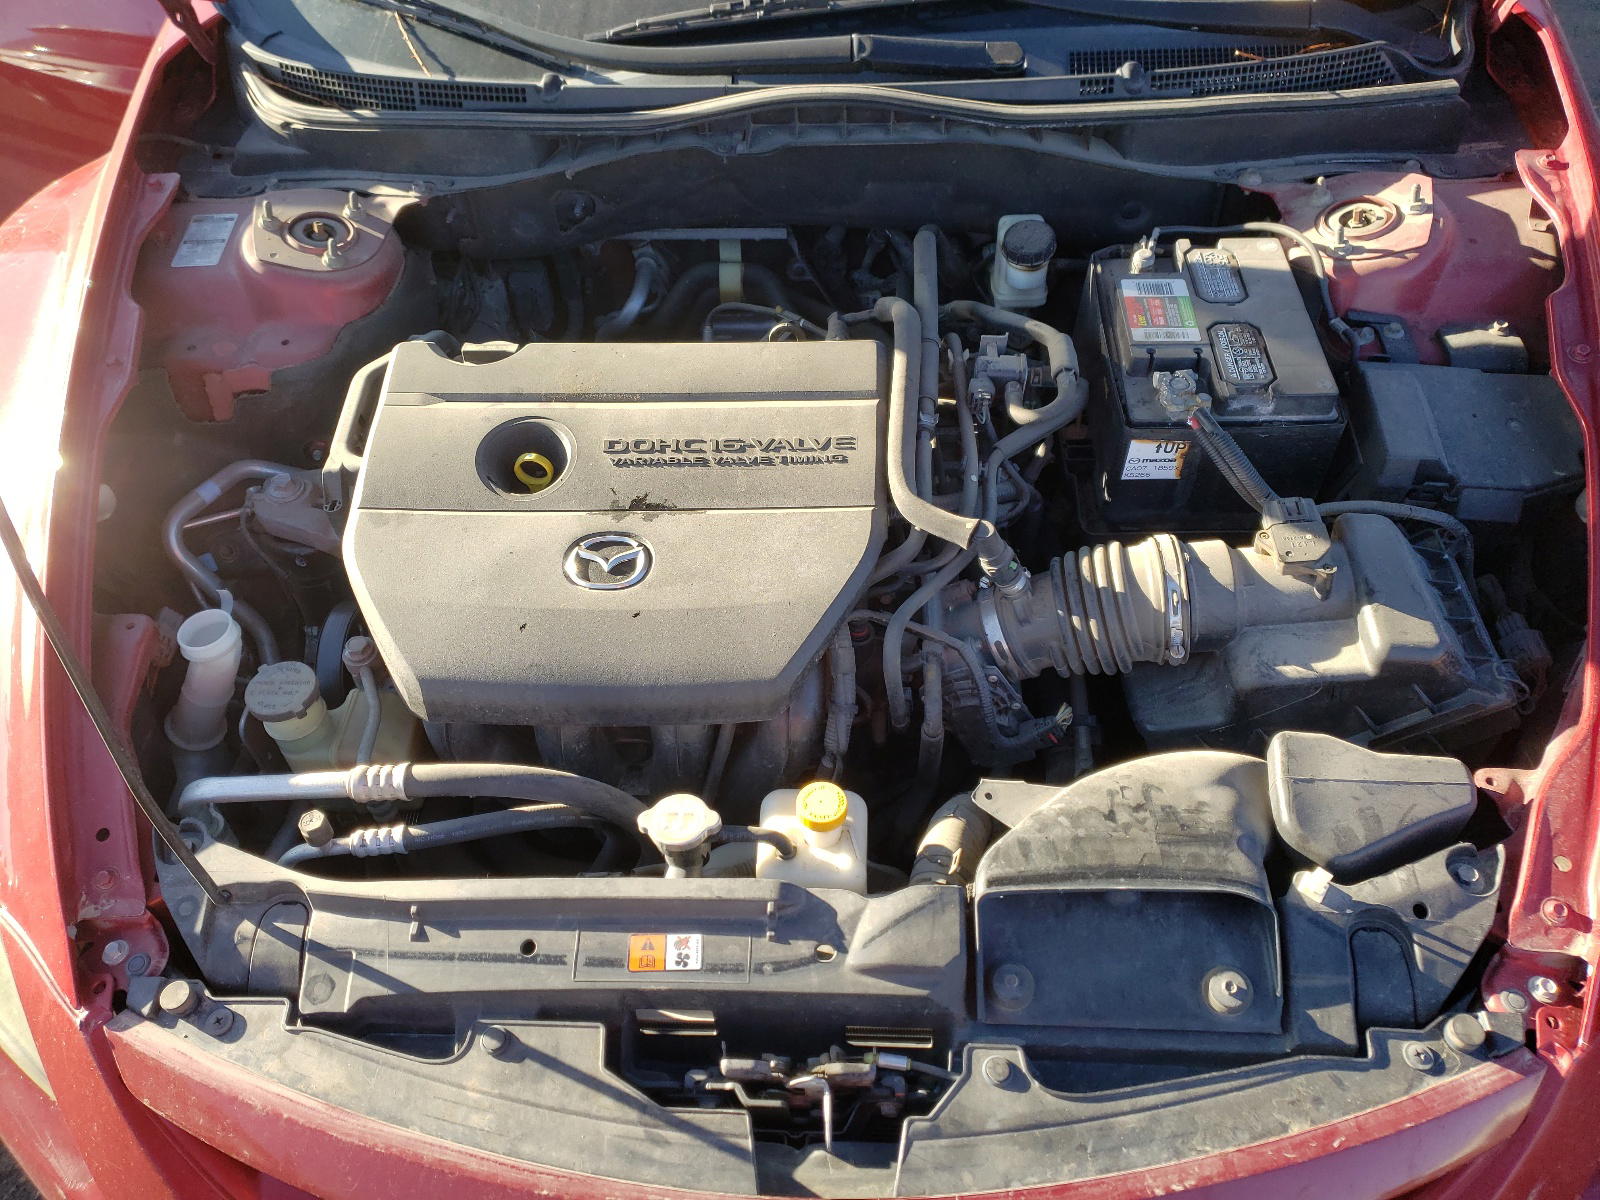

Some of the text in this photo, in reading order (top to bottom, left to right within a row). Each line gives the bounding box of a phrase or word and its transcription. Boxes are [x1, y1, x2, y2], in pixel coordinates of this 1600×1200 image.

[603, 435, 857, 454] DOHC 16-VALVE
[1163, 442, 1186, 454] UP
[609, 453, 849, 467] VARIABLE VALVE TIMING
